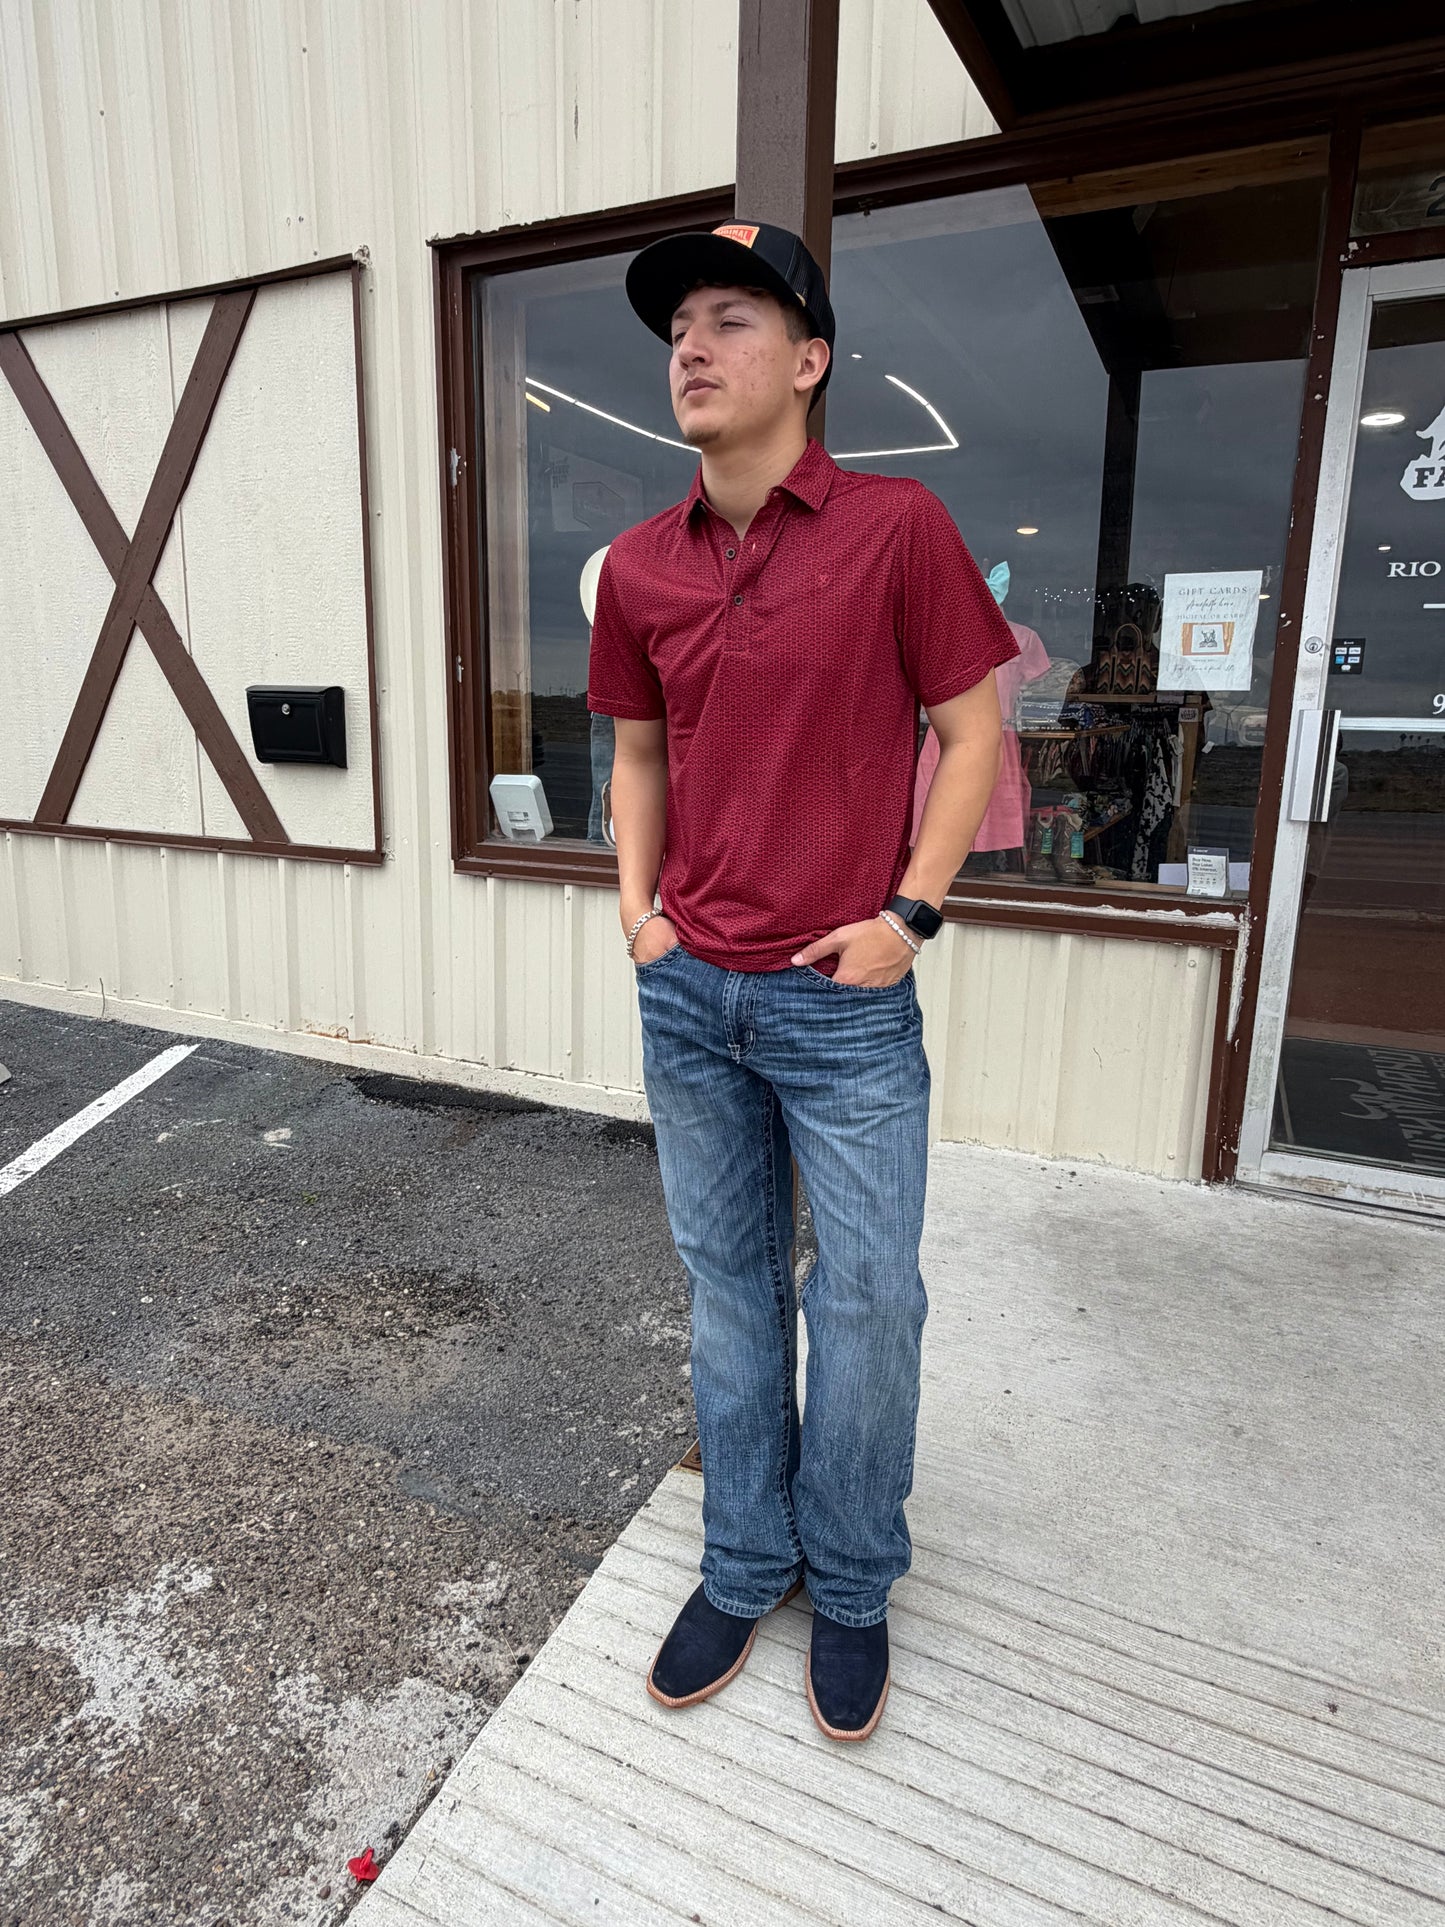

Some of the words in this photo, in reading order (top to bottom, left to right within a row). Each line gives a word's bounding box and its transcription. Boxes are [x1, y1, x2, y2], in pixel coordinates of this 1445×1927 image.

[1387, 561, 1441, 577] RIO
[1178, 587, 1204, 596] GIFT
[1210, 585, 1248, 595] CARDS
